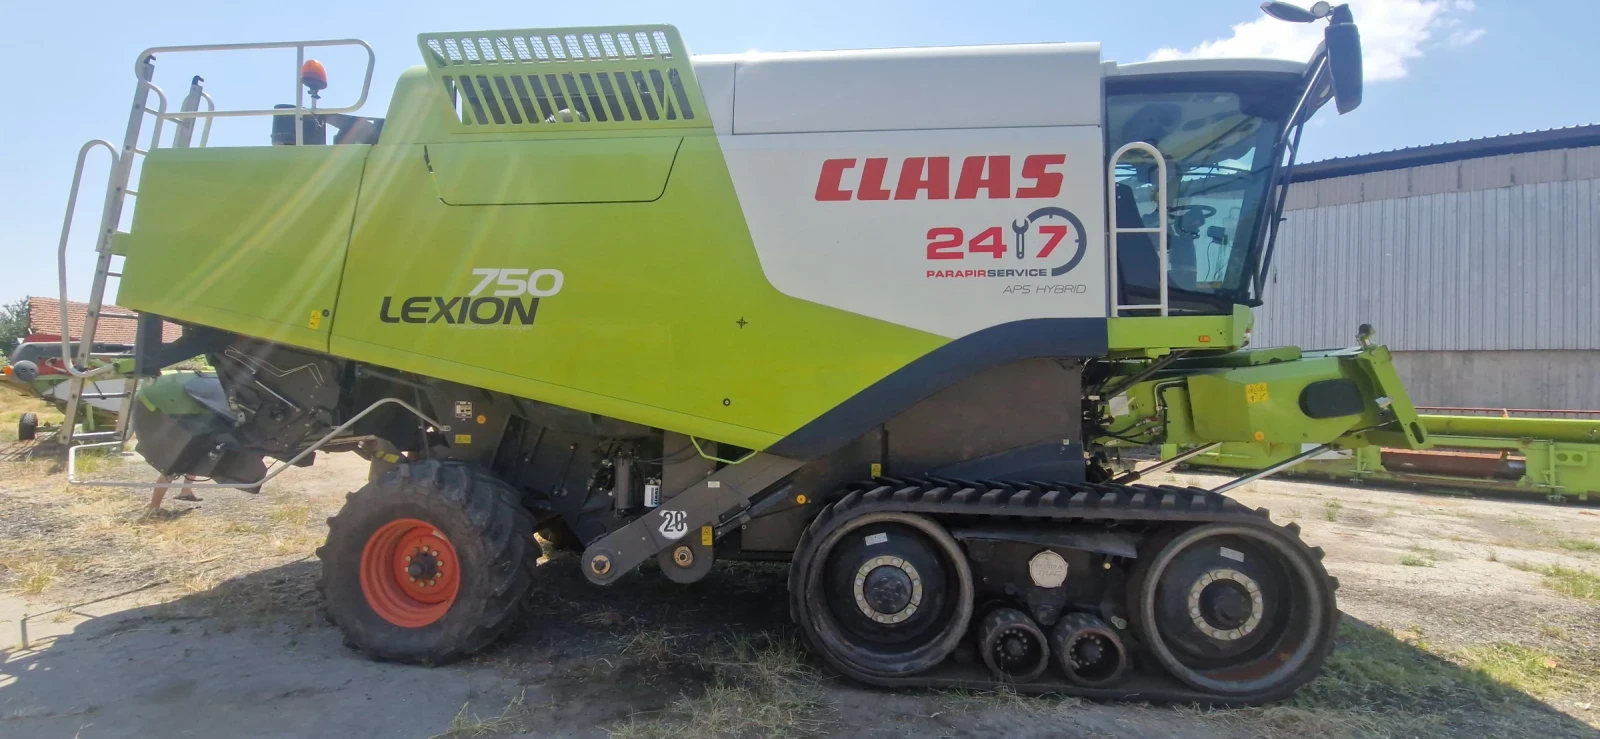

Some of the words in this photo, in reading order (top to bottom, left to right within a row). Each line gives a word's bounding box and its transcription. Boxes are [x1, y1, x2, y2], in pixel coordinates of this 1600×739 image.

[814, 154, 1067, 202] CLAAS
[468, 268, 565, 297] 750
[926, 268, 1047, 278] PARAPIRSERVICE
[1002, 284, 1031, 294] APS
[1035, 284, 1087, 294] HYBRID
[379, 296, 541, 326] LEXION
